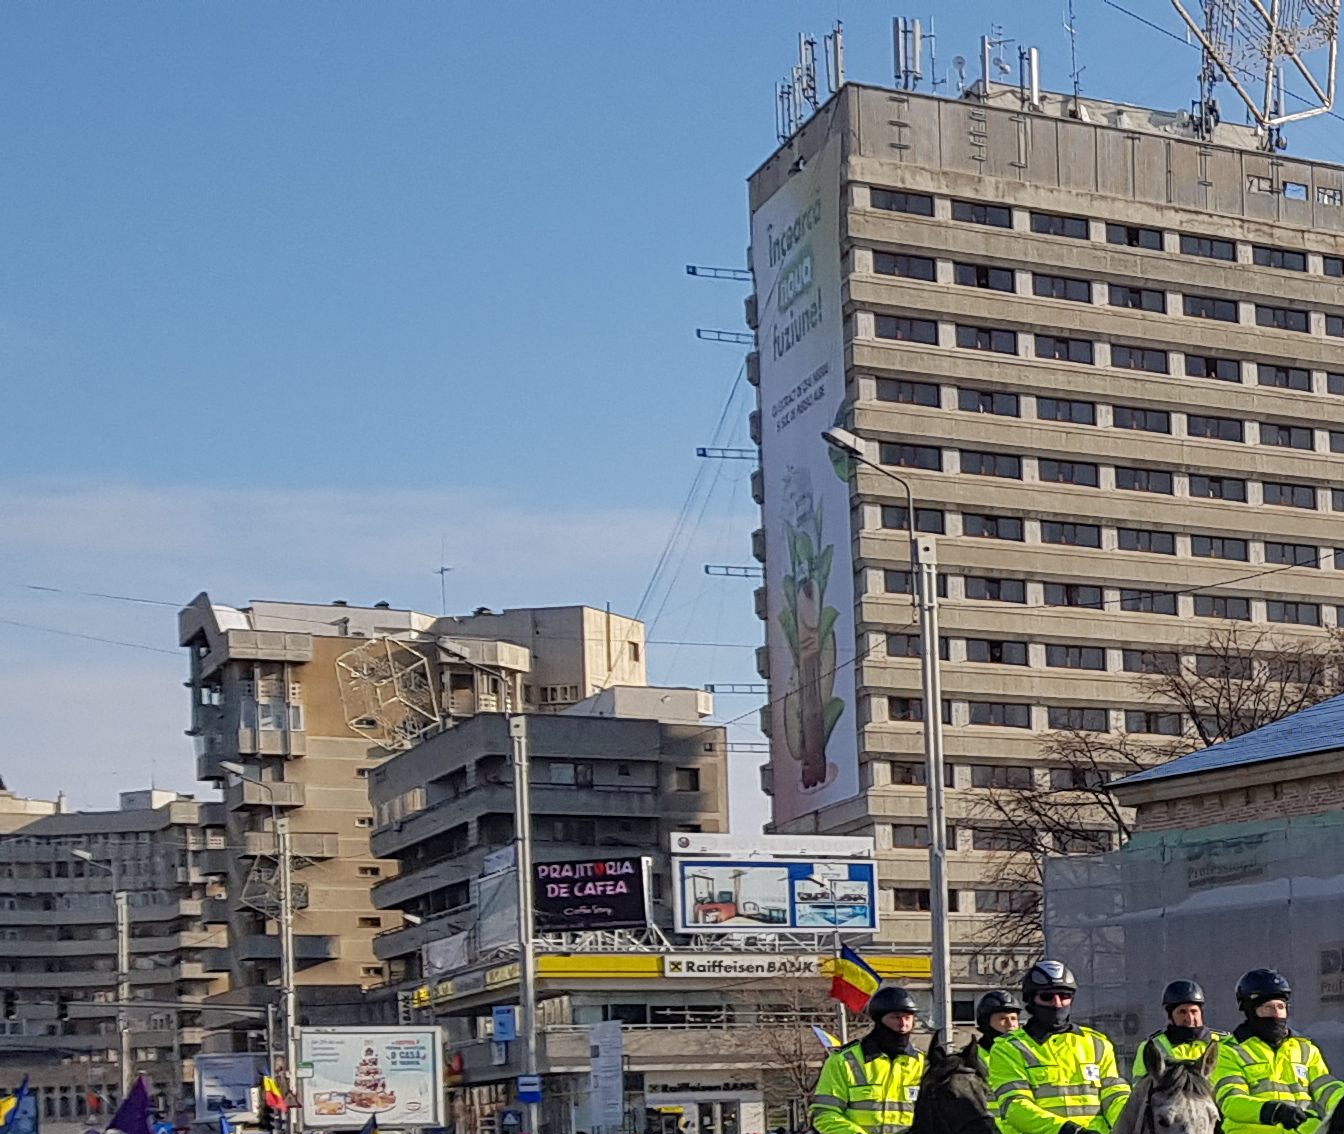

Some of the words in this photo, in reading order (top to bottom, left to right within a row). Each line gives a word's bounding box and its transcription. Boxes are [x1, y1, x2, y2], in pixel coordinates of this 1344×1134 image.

[773, 287, 822, 361] fuziune!
[546, 883, 570, 898] DE
[574, 880, 628, 897] CAFEA
[686, 960, 765, 973] Raiffeisen
[766, 960, 814, 973] BANK
